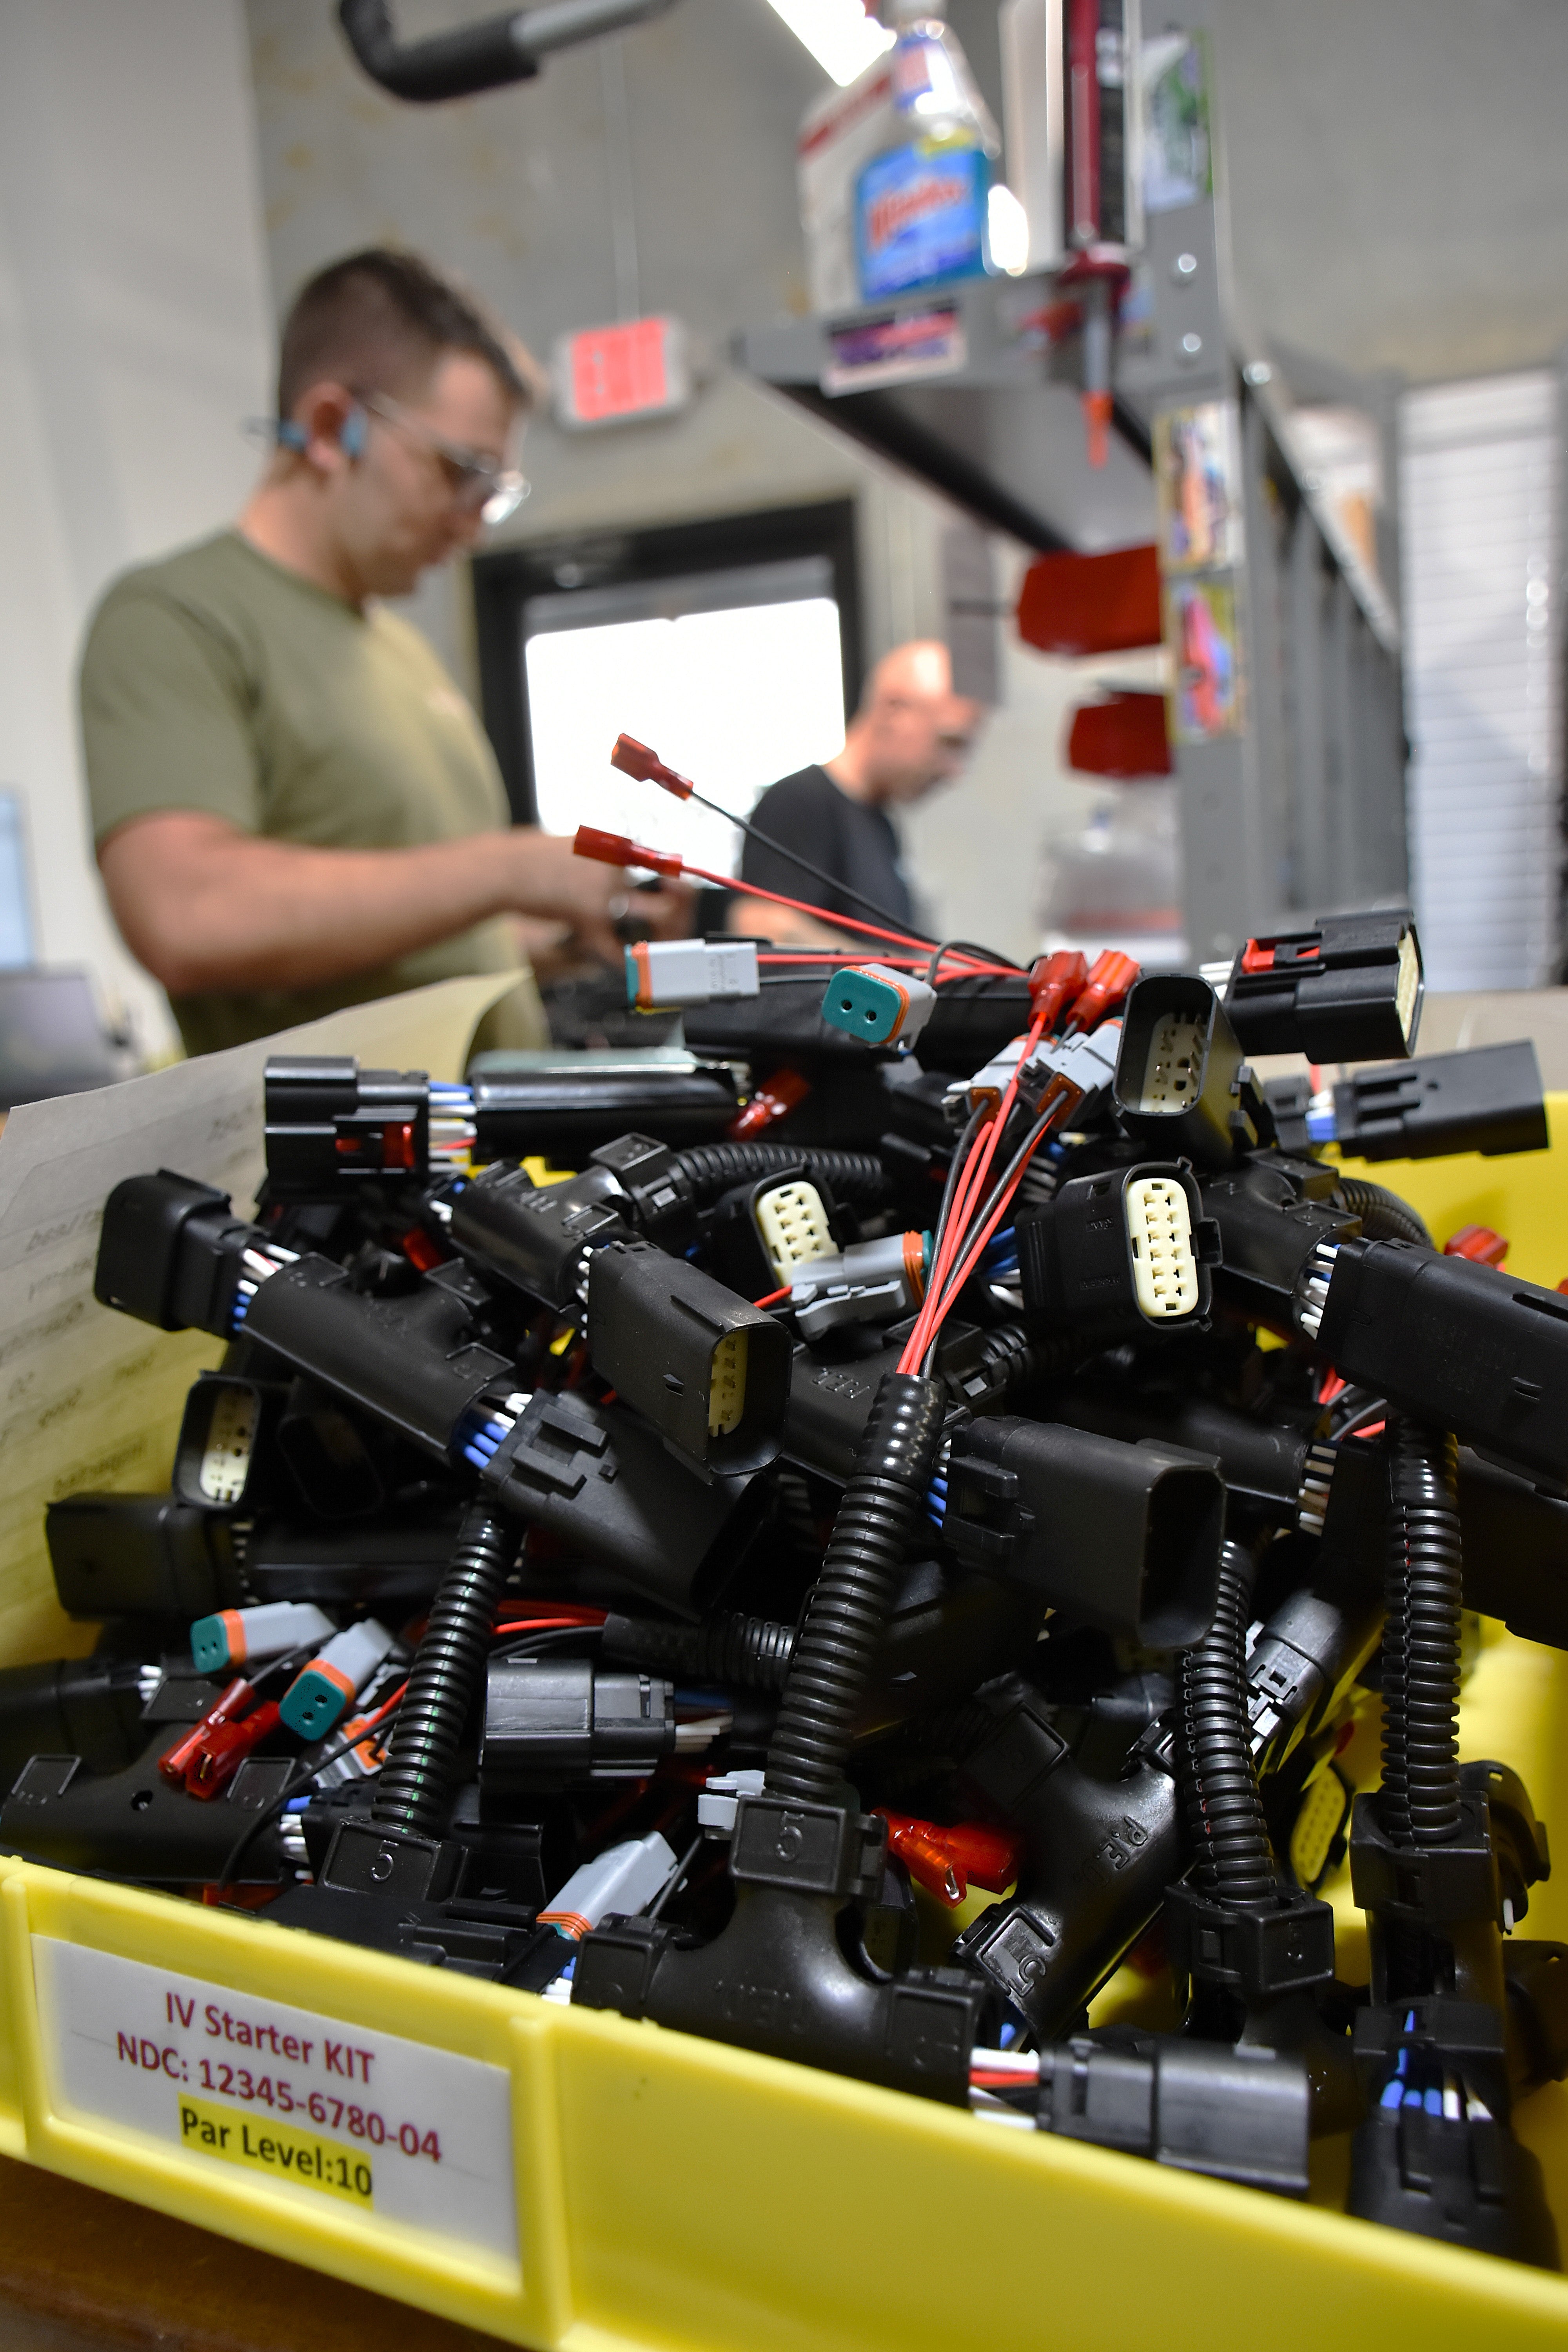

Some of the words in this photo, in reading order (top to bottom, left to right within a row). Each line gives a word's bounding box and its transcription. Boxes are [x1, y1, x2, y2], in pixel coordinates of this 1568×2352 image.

[370, 1840, 399, 1883] 5
[775, 1810, 805, 1862] 5
[1008, 1953, 1046, 1998] 5
[166, 1992, 195, 2028] IV
[205, 2005, 313, 2063] Starter
[325, 2039, 375, 2083] KIT
[117, 2031, 189, 2082] NDC:
[199, 2059, 442, 2163] 12345-6780-04
[181, 2107, 230, 2149] Par
[243, 2125, 372, 2196] Level:10
